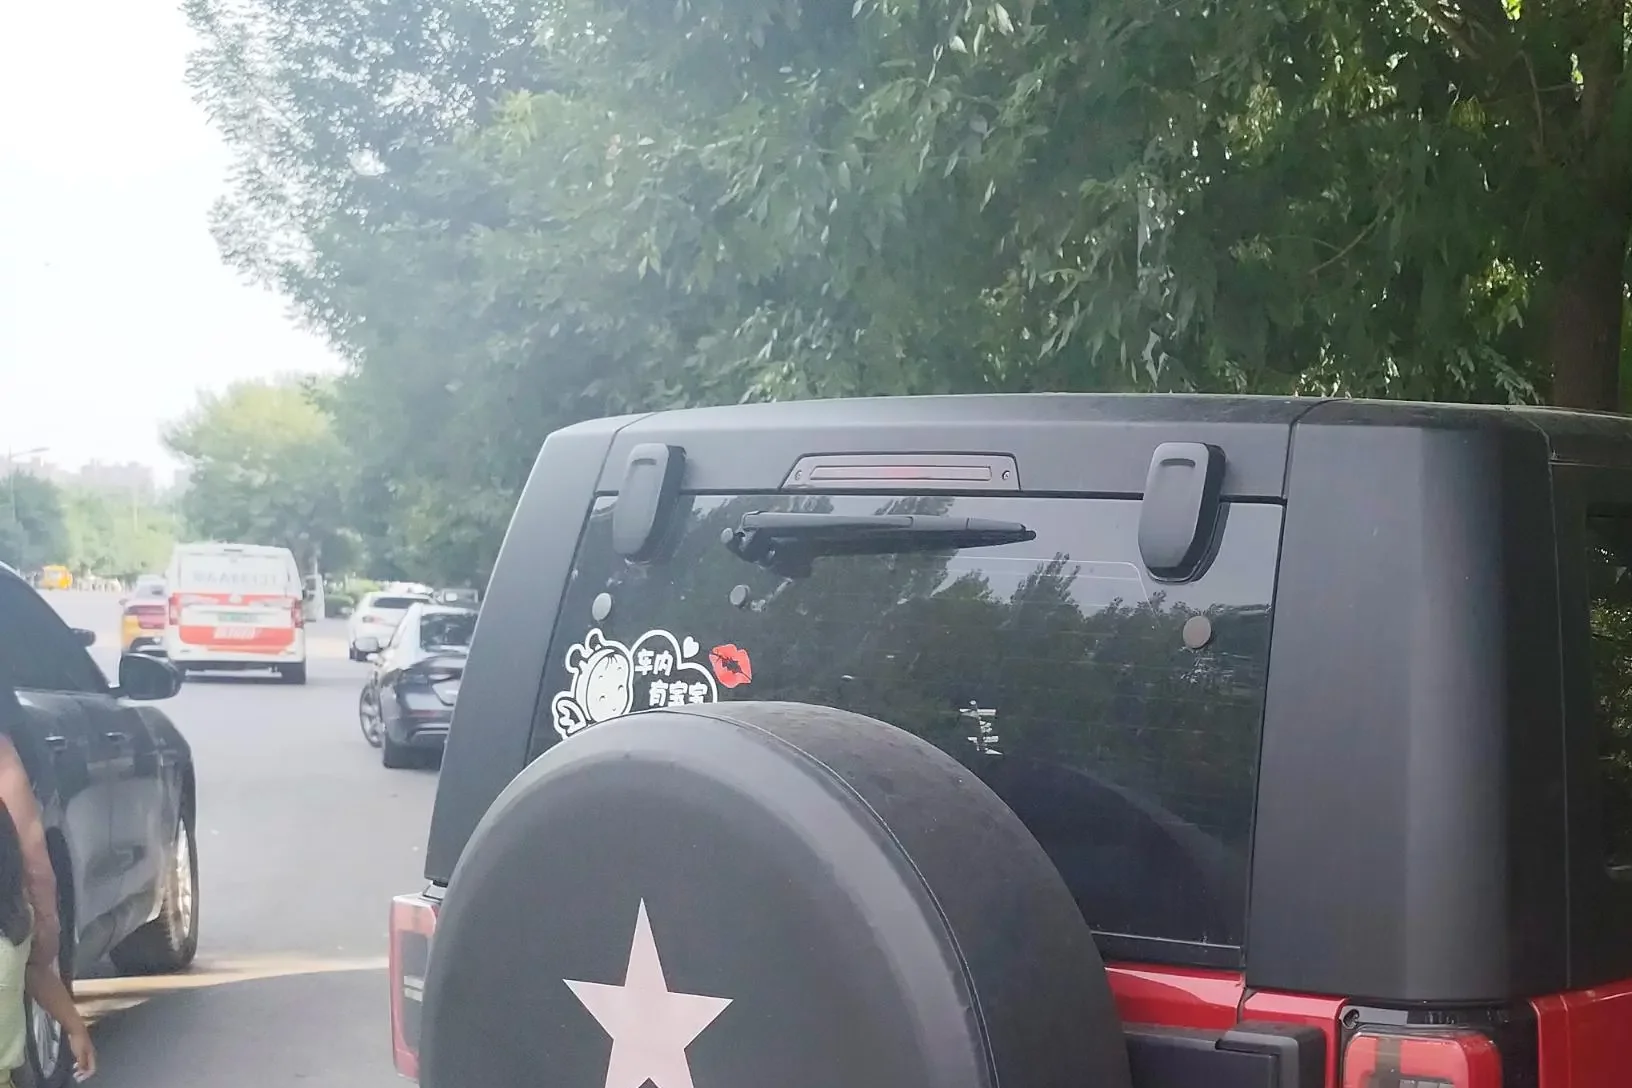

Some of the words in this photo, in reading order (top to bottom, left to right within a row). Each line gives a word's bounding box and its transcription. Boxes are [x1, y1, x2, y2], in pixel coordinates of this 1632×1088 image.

[635, 648, 674, 676] 车内
[648, 679, 708, 707] 有宝宝
